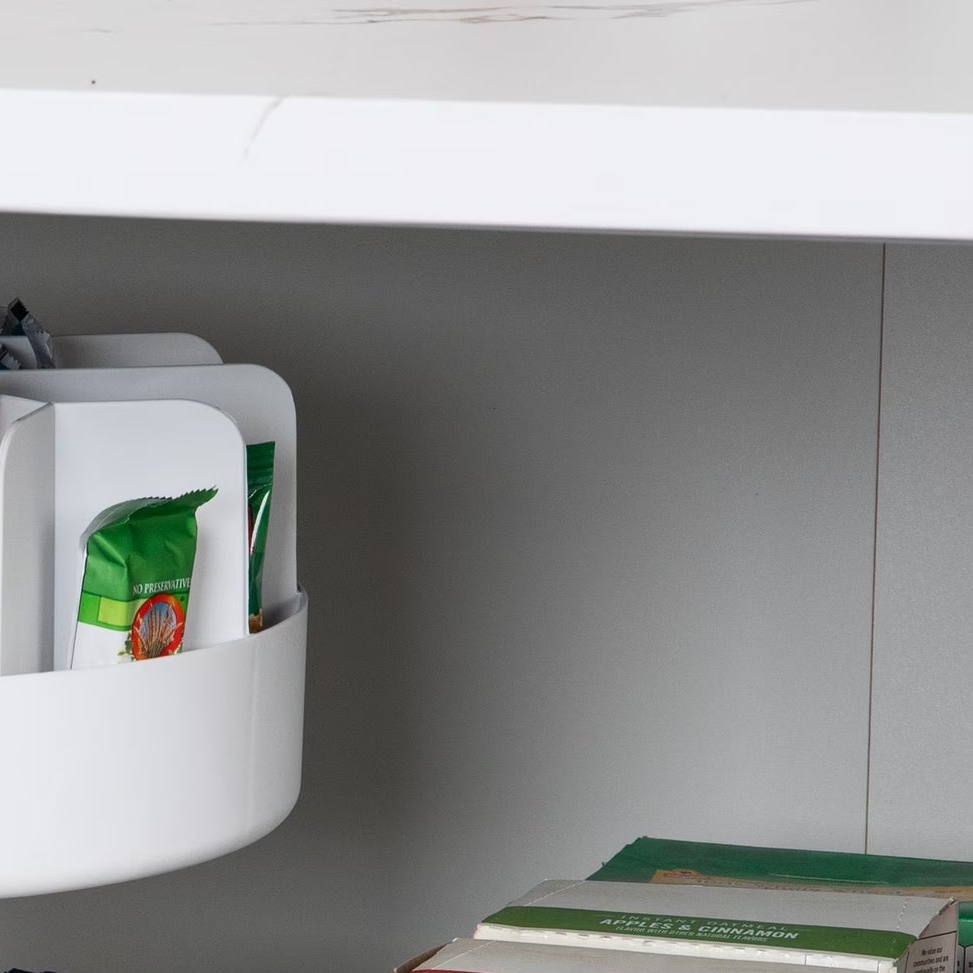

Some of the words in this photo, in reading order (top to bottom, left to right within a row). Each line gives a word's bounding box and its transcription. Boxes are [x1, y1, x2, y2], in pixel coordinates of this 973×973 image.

[132, 582, 144, 595] NO
[600, 918, 676, 930] APPLES
[677, 924, 691, 932] &
[698, 925, 799, 939] CINNAMON
[620, 915, 698, 925] INSTANT
[706, 920, 789, 932] OATMEAL
